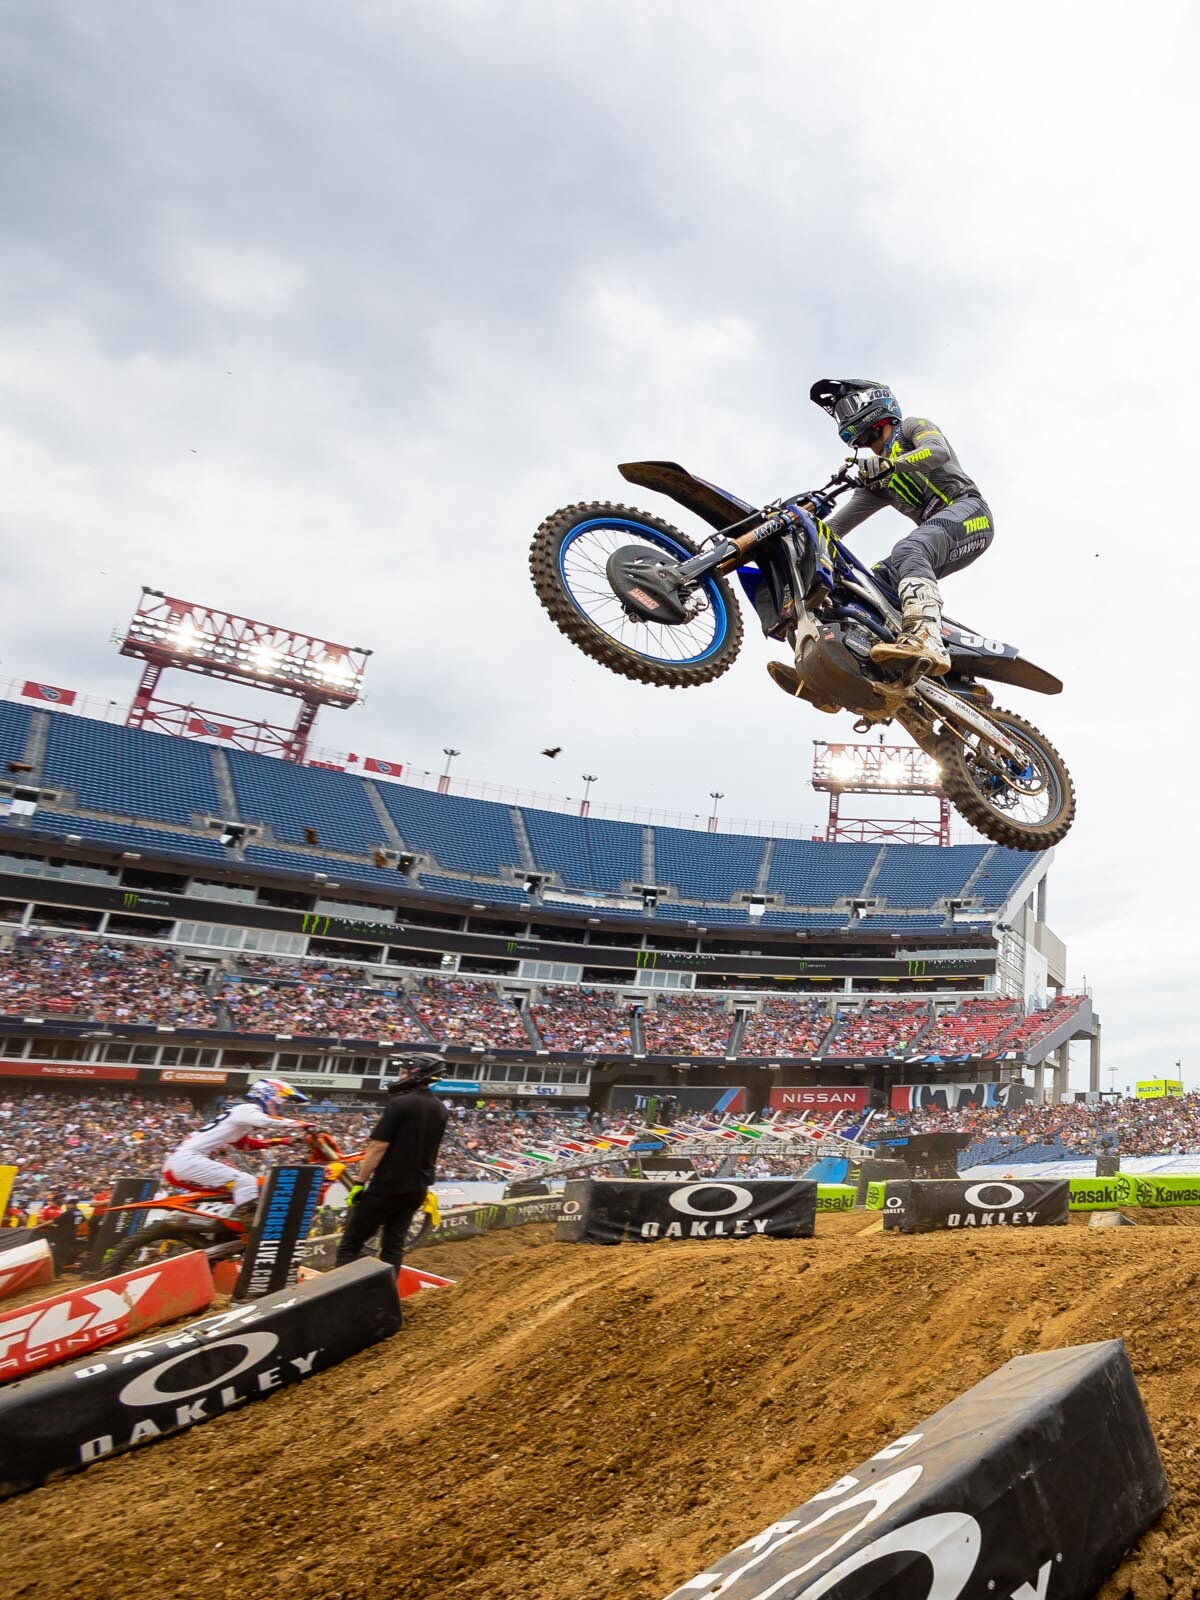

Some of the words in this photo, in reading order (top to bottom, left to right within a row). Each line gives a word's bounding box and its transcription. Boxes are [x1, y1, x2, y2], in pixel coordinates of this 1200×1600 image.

[904, 448, 932, 463] THOR
[963, 516, 990, 535] THOR
[41, 1066, 96, 1075] NISSAN
[782, 1093, 856, 1103] NISSAN
[947, 1211, 1038, 1227] OAKLEY
[640, 1219, 766, 1238] OAKLEY
[80, 1348, 318, 1463] OAKLEY
